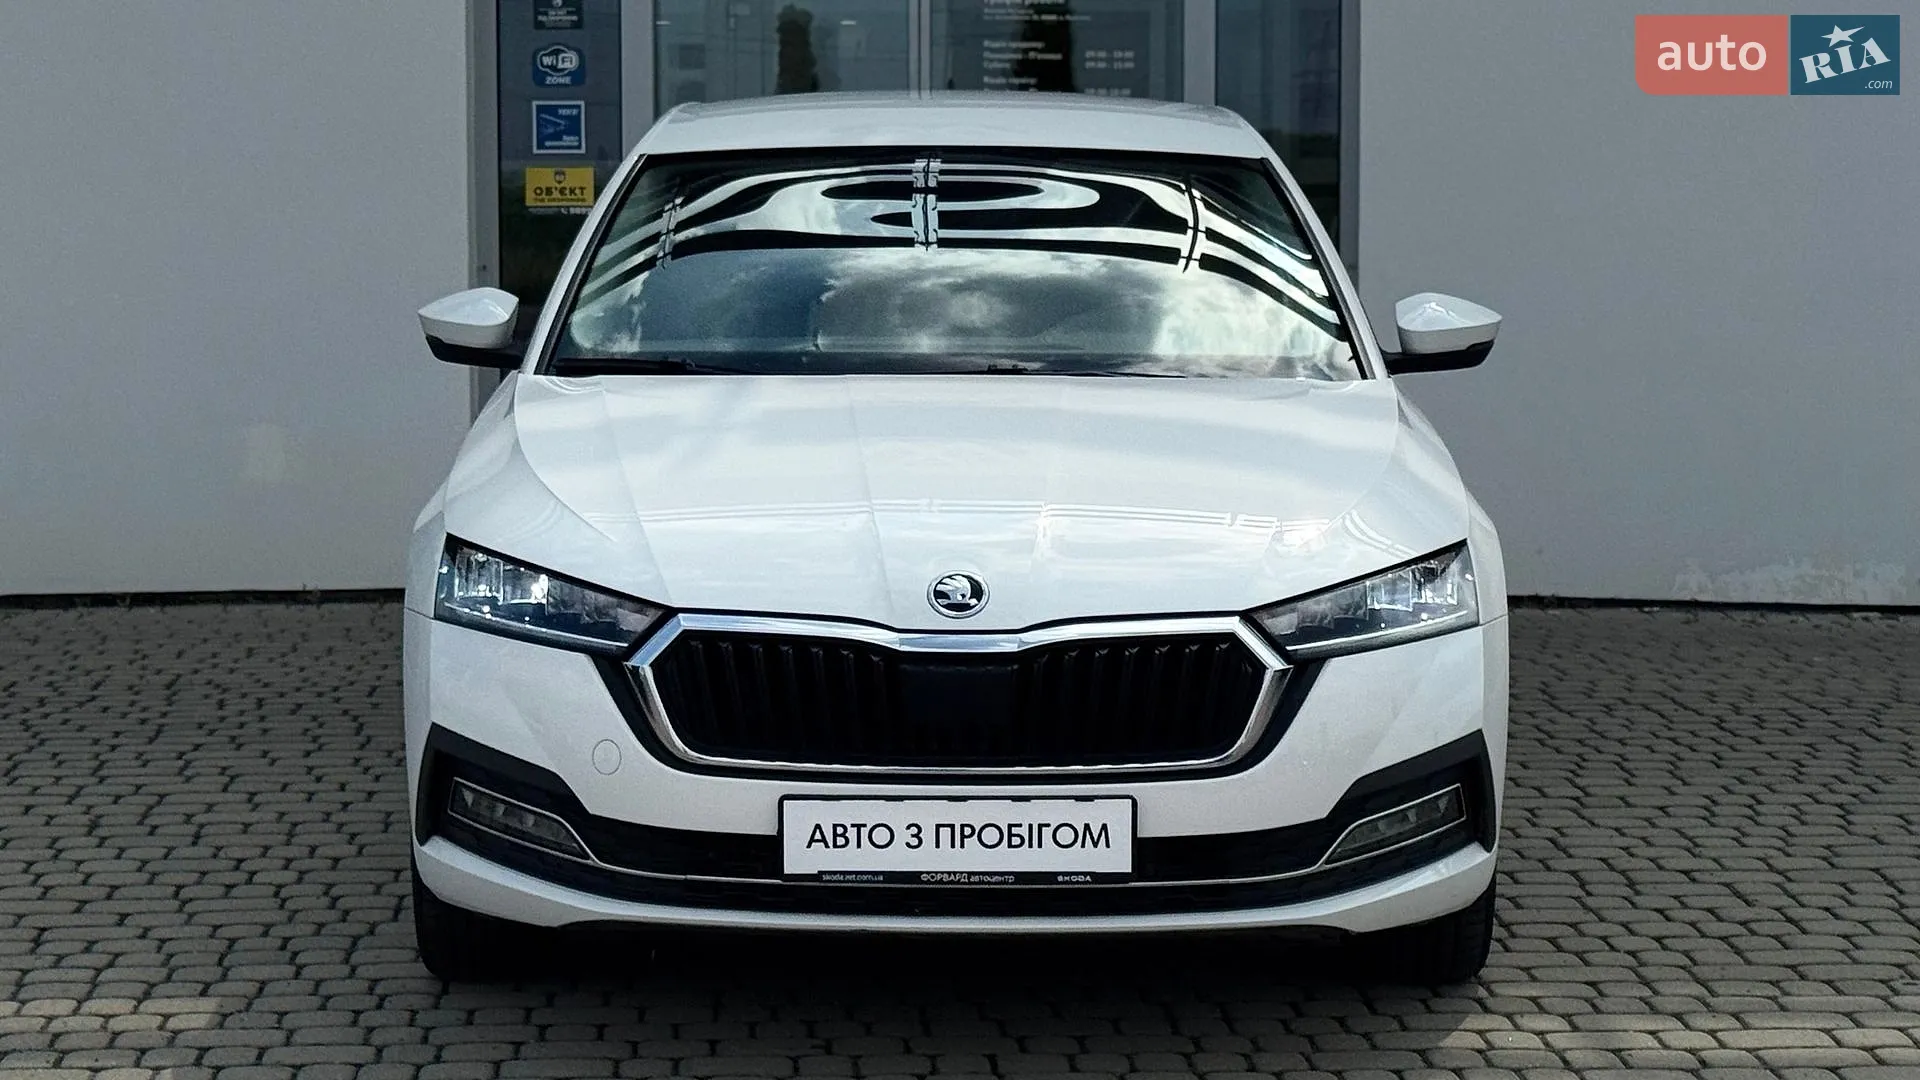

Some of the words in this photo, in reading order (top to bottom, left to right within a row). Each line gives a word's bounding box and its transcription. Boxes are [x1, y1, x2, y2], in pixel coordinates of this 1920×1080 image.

[545, 76, 571, 85] ZONE
[806, 823, 895, 849] АВТО
[935, 823, 1111, 849] ПРОБІГОМ
[920, 873, 968, 882] ФОРВАРД
[969, 874, 1015, 882] автоцентр
